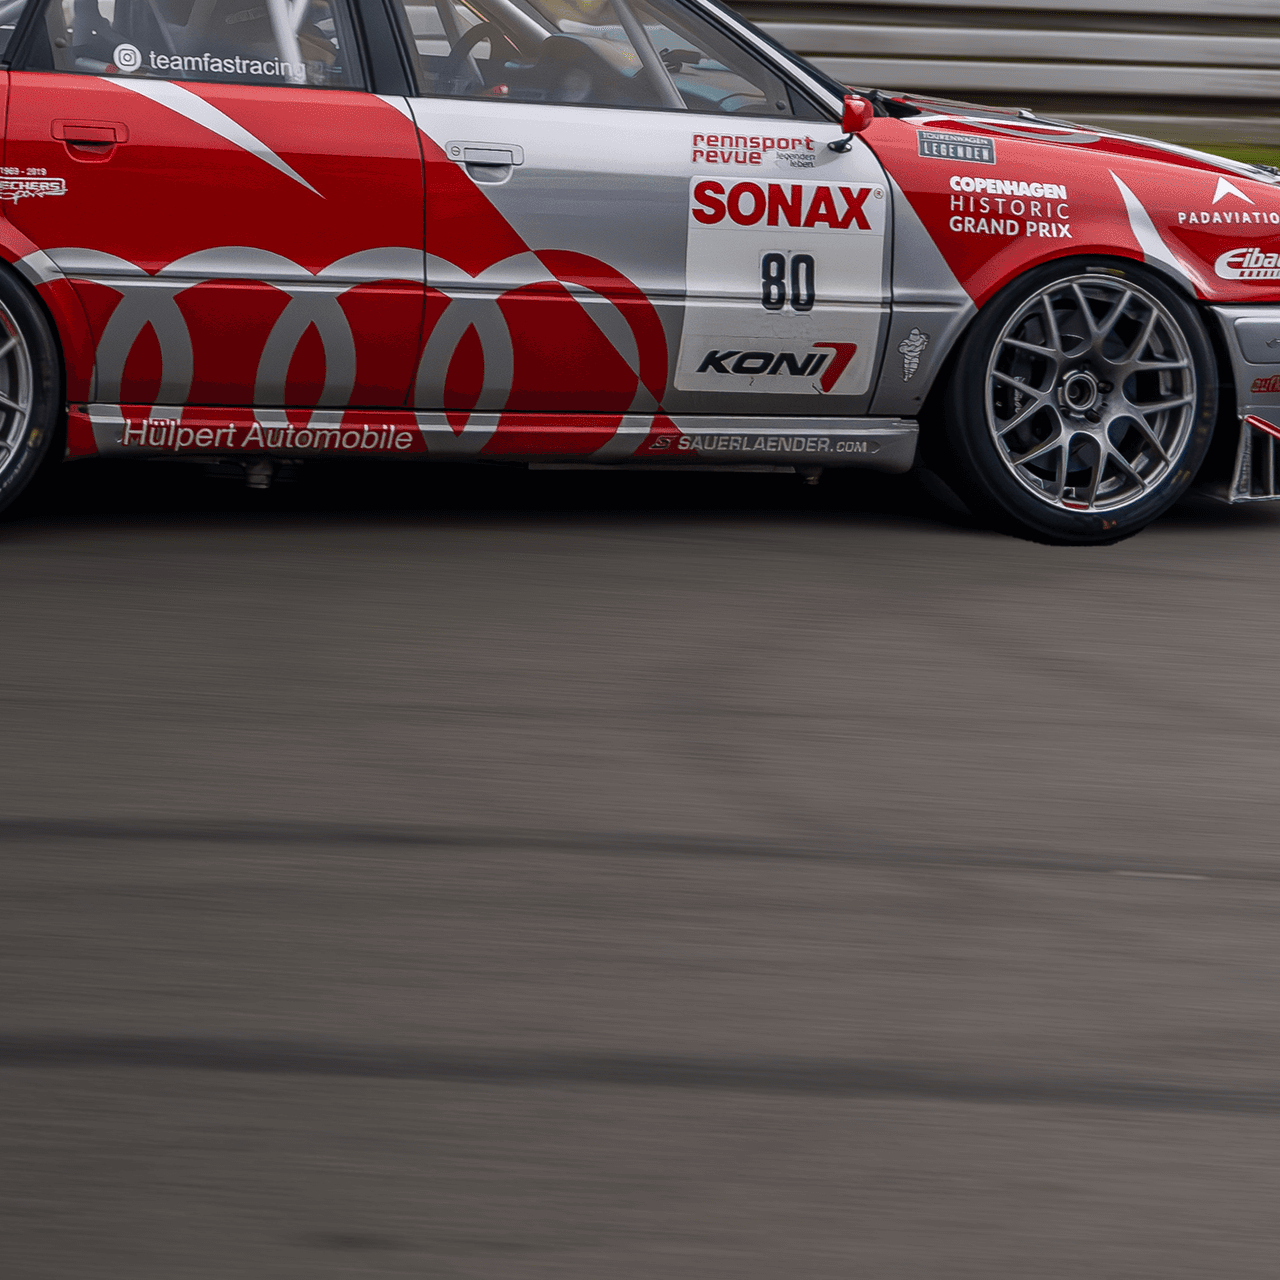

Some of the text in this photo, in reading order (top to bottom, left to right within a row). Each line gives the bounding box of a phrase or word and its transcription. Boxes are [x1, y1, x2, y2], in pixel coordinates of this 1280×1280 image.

[692, 134, 815, 152] rennsport
[923, 141, 990, 160] LEGENDEN
[691, 149, 762, 164] revue
[949, 176, 1068, 200] COPENHAGEN
[691, 180, 872, 231] SONAX
[950, 194, 1070, 220] HISTORIC
[949, 215, 1073, 238] GRAND PRIX
[761, 252, 816, 312] 80
[696, 349, 830, 376] KONI
[122, 418, 413, 451] Hülpert Automobile
[677, 435, 867, 453] SAUERLAENDER.COM
